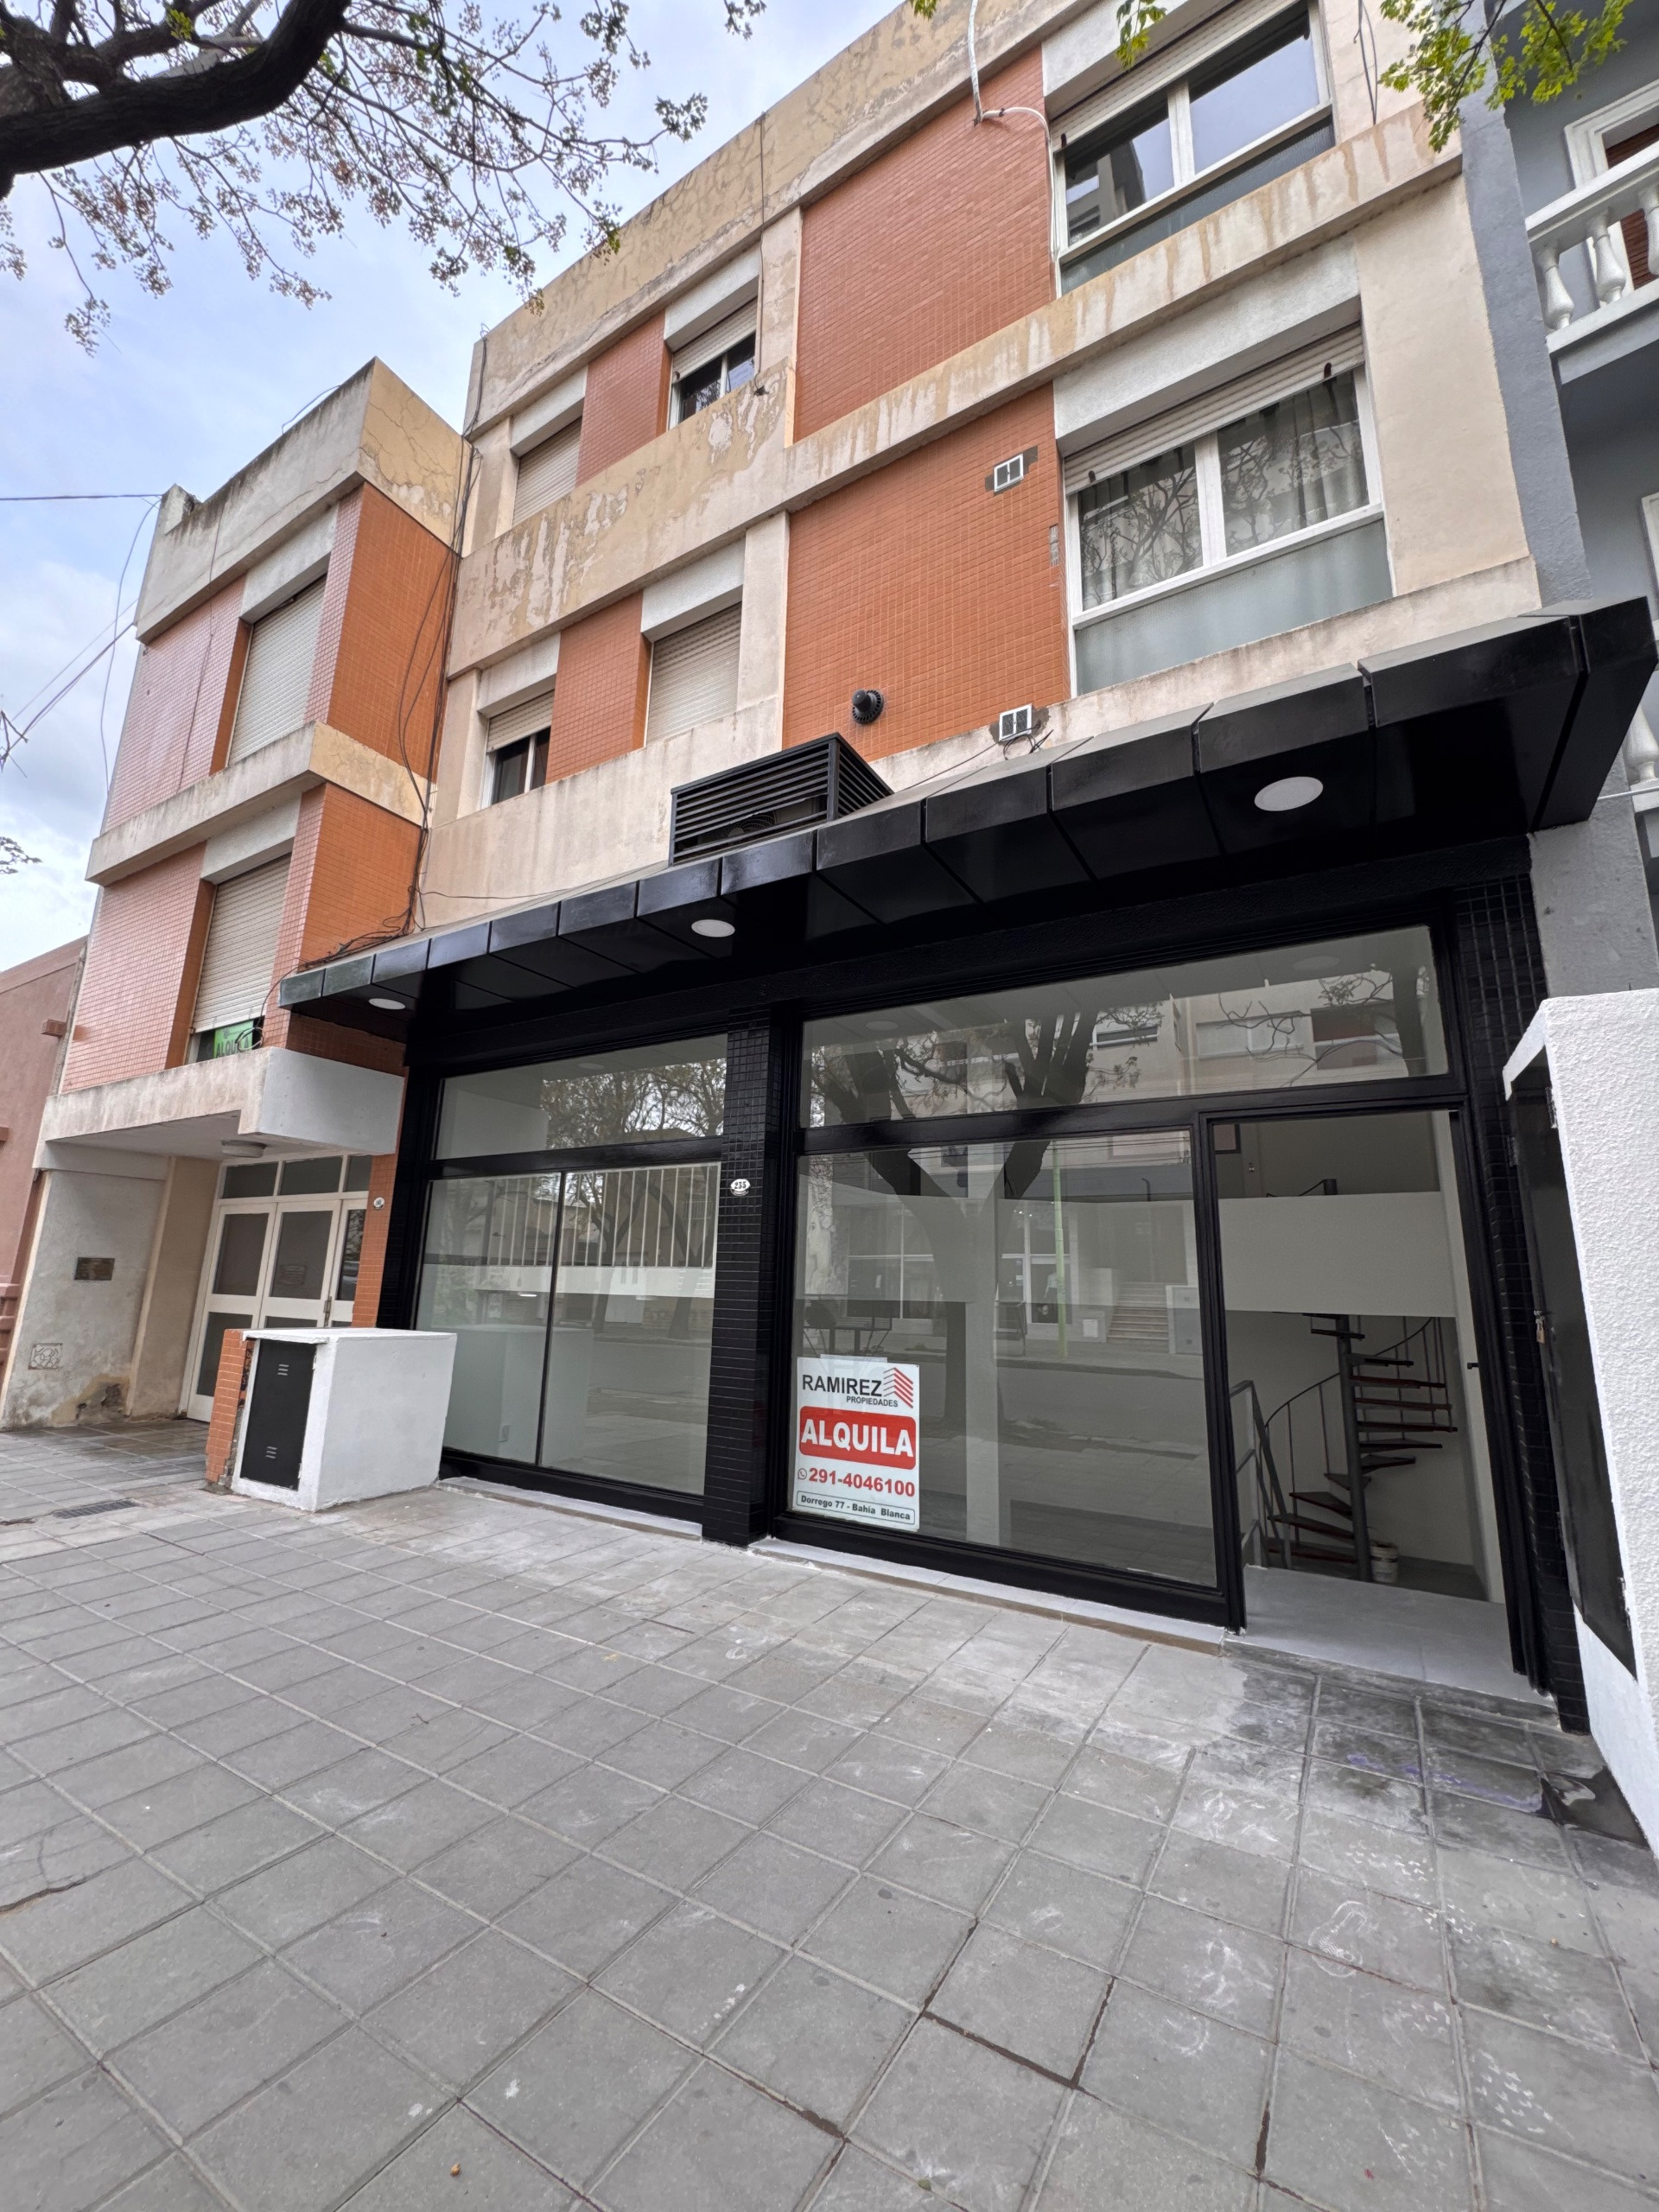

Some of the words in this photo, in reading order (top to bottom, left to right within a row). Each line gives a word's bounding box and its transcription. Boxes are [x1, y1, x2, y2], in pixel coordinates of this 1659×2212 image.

[216, 1036, 250, 1058] ALQUA
[734, 1181, 747, 1190] 235
[803, 1374, 882, 1397] RAMIREZ
[847, 1395, 899, 1408] PROPIEDADES
[801, 1419, 914, 1458] ALQUILA
[809, 1467, 916, 1497] 291-4046100
[801, 1495, 833, 1508] Dorrego
[835, 1500, 845, 1509] 77
[880, 1508, 911, 1520] Blanca
